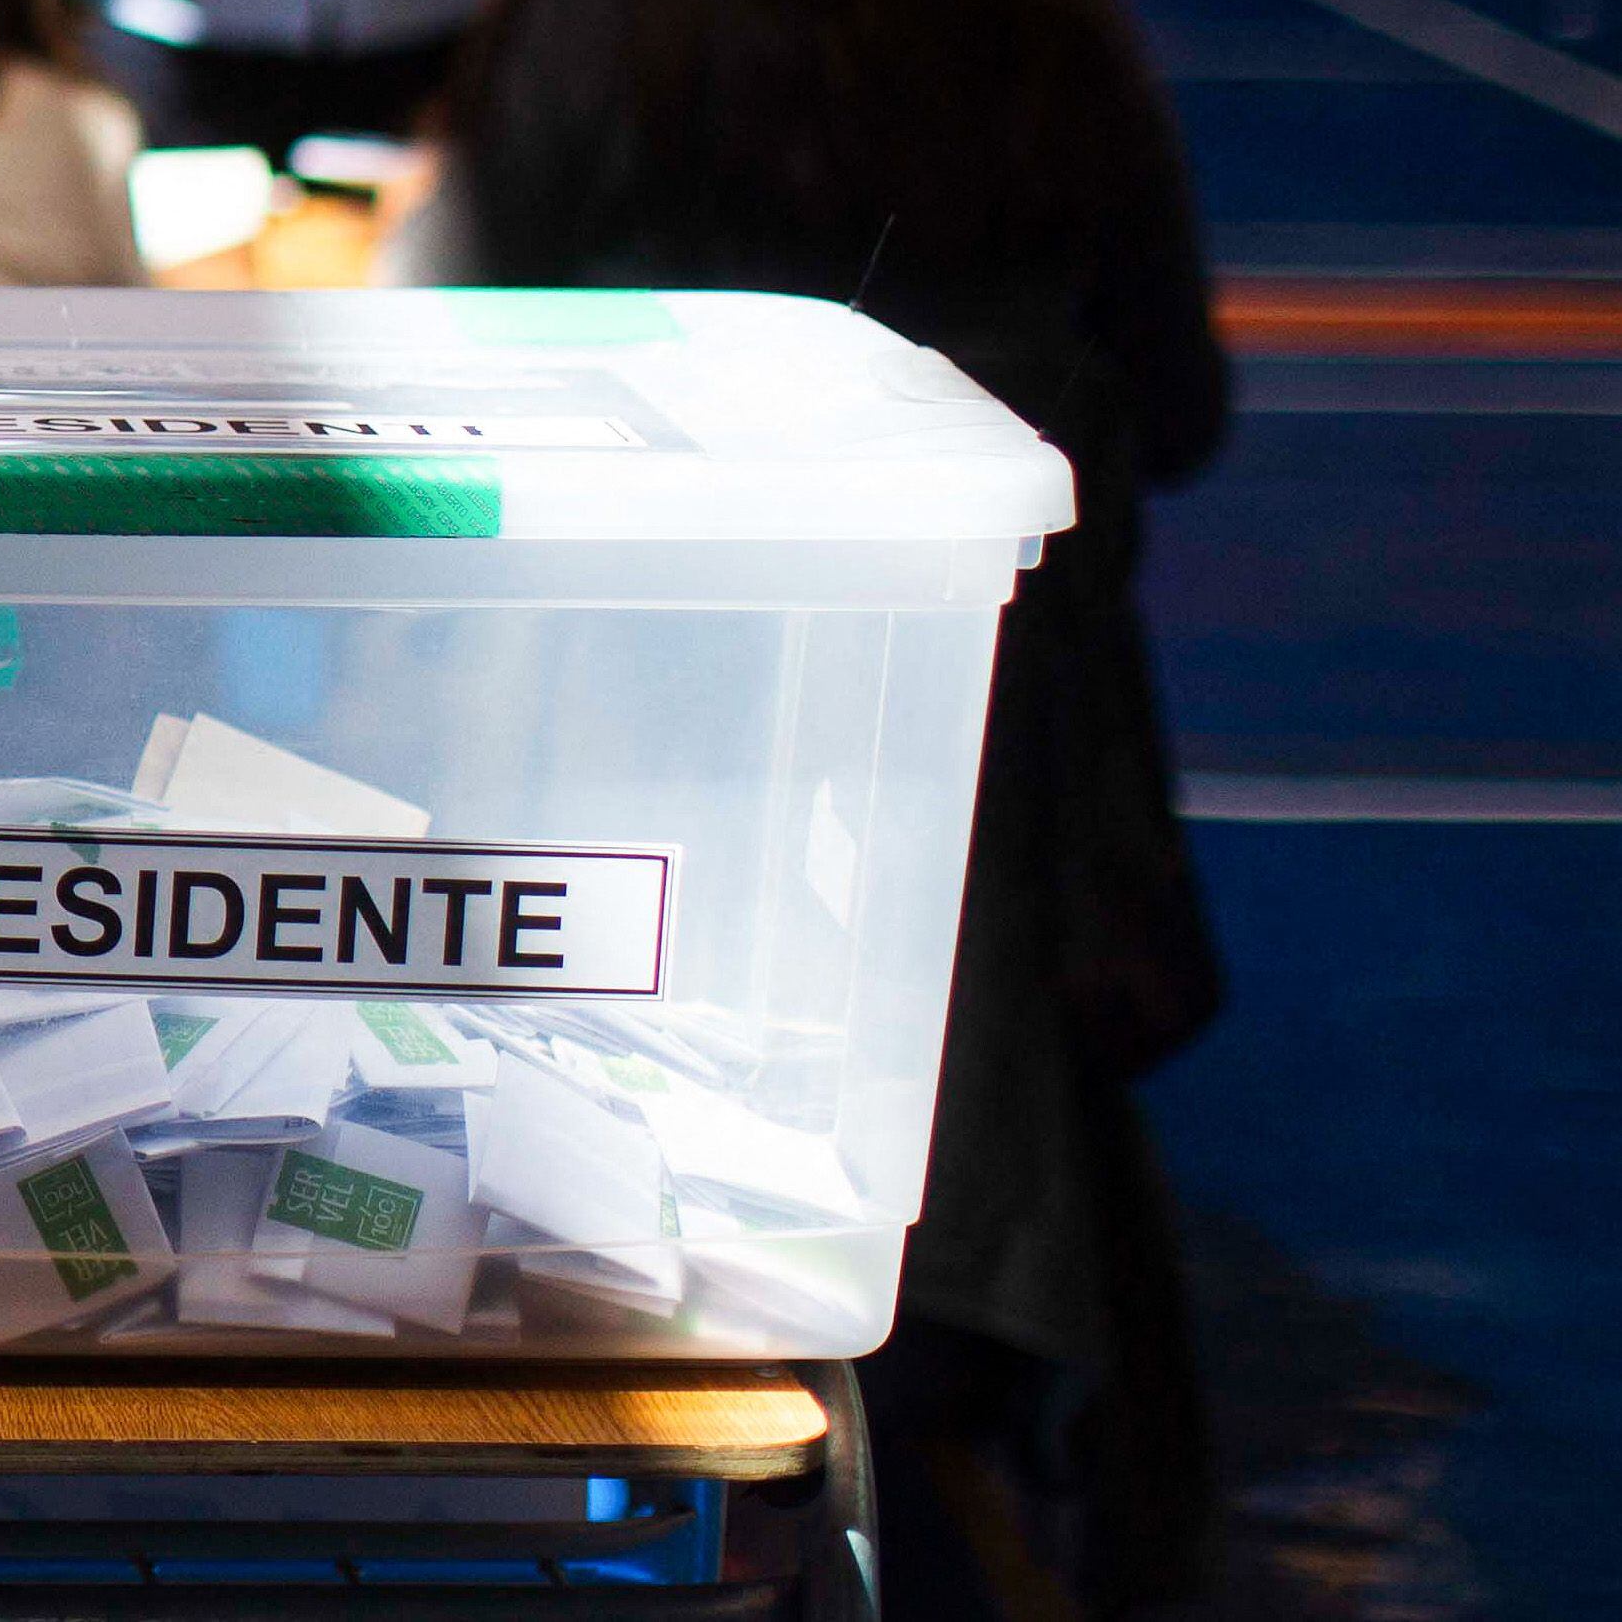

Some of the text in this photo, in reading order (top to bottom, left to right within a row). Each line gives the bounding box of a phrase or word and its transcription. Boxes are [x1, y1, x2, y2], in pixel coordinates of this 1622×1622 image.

[286, 1169, 324, 1217] SER
[315, 1183, 356, 1222] VEL
[58, 1218, 109, 1253] VEL
